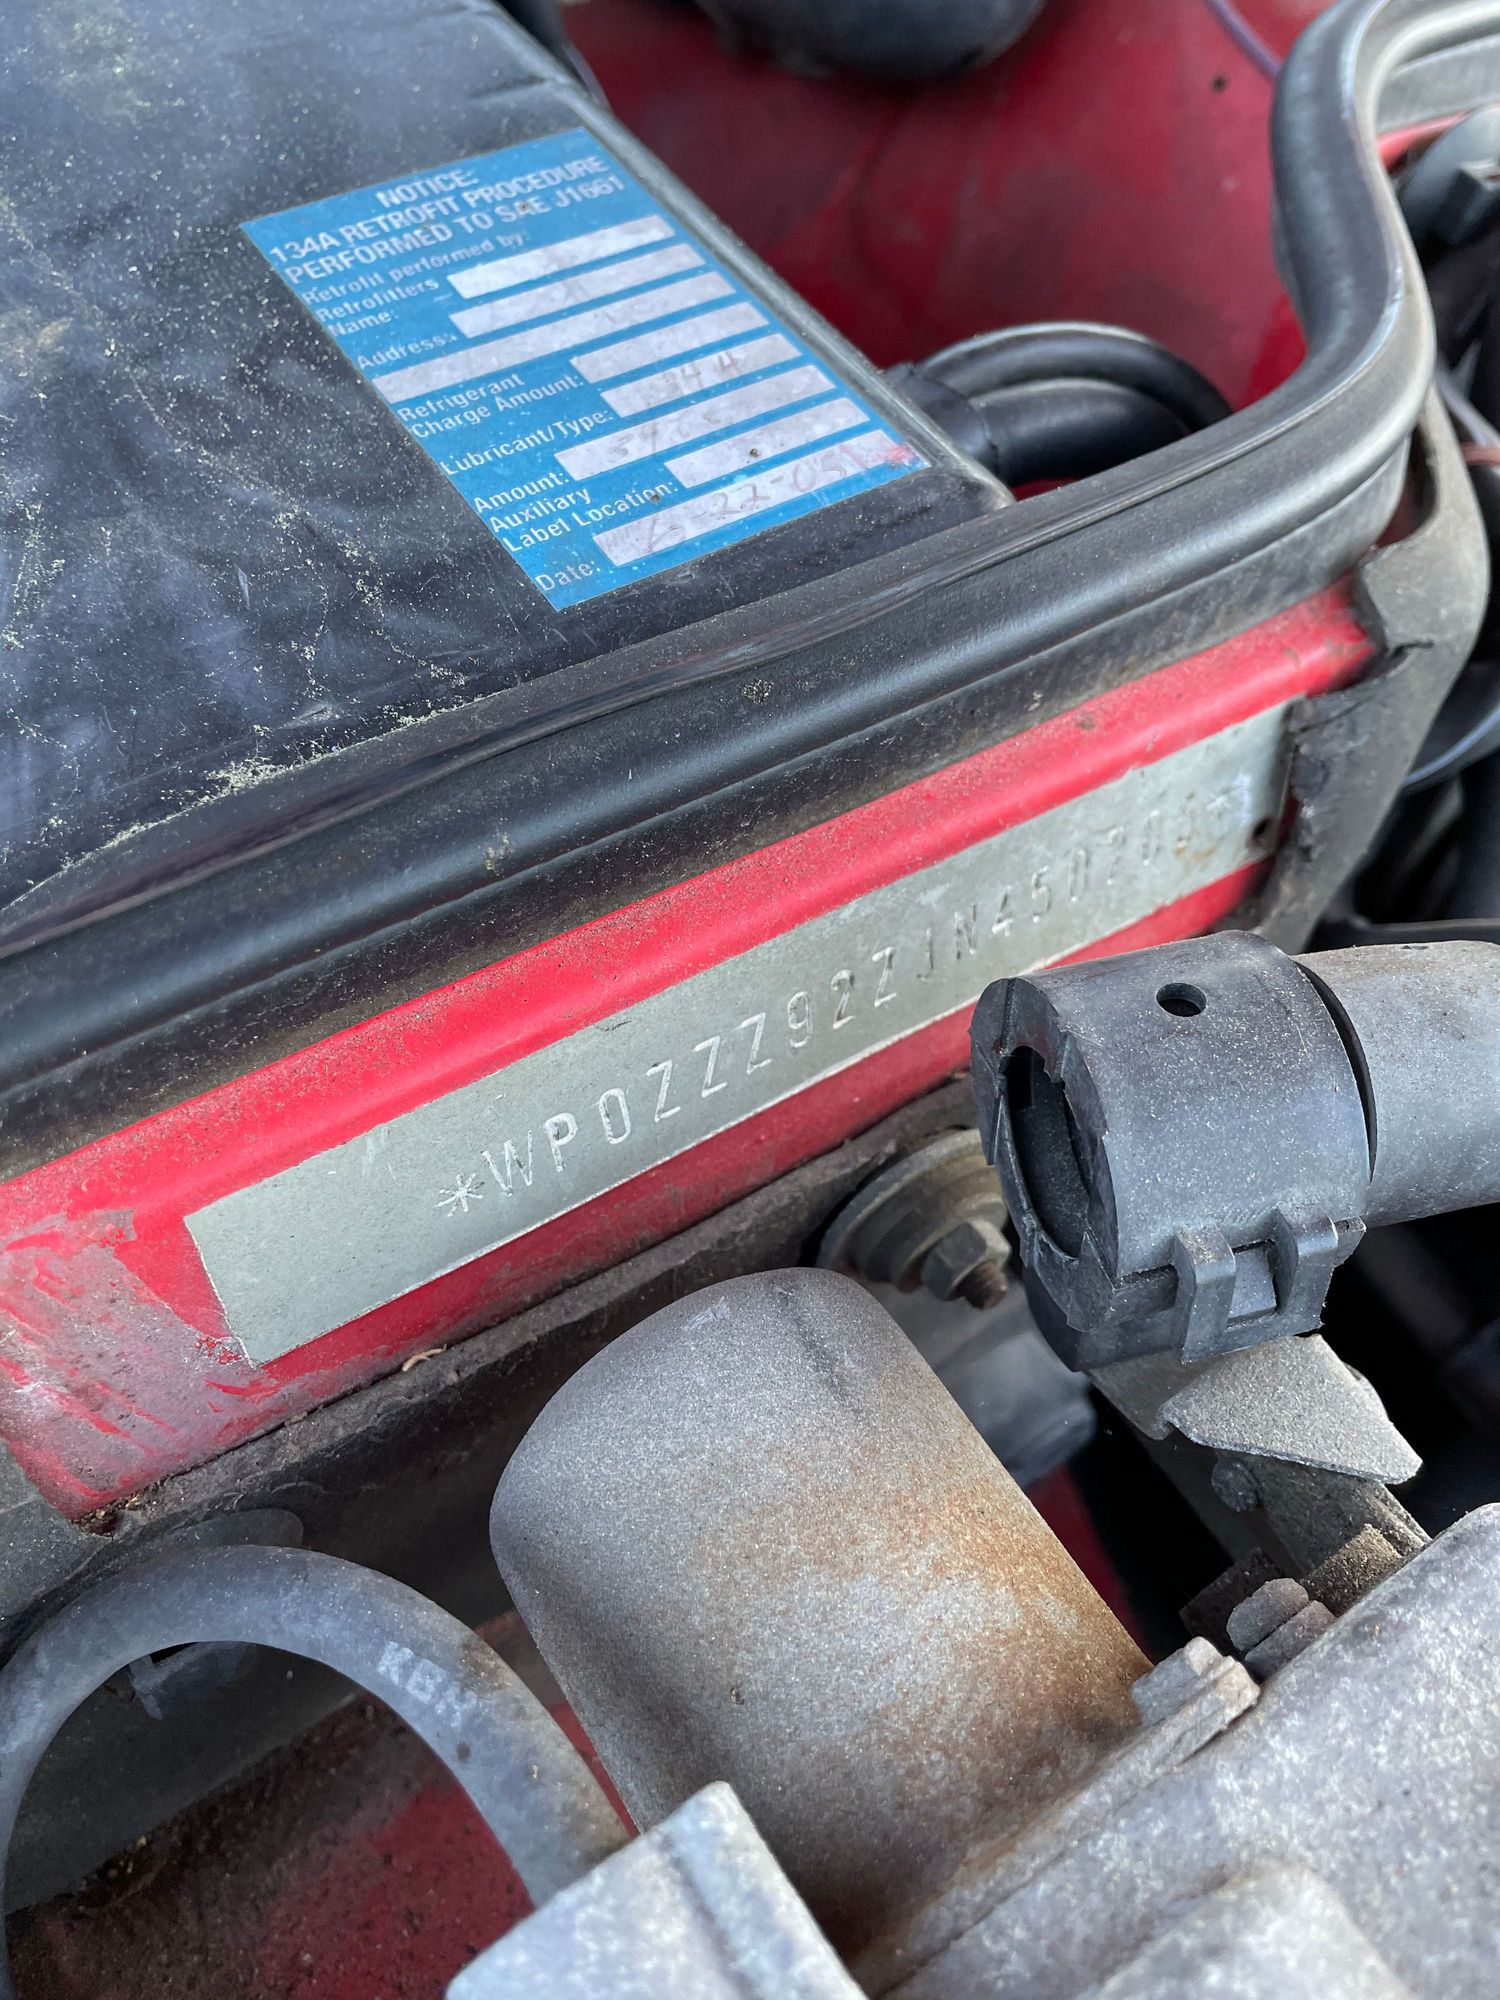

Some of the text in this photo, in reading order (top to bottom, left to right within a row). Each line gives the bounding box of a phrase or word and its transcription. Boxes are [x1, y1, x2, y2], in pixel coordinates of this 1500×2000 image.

[270, 156, 610, 263] 134A RETROFIT PROCEDURE
[375, 169, 480, 208] NOTICE:
[284, 174, 625, 284] PERFORMED TO SAE J1661
[301, 271, 385, 305] Retrofit
[388, 239, 495, 283] performed
[315, 278, 439, 323] Retrofitters
[326, 309, 399, 337] Name:
[397, 373, 525, 423] Refrigerant
[410, 374, 584, 438] Charge Amount:
[439, 409, 614, 475] Lubricant/Type:
[473, 471, 570, 513] Amount:
[489, 488, 592, 533] Auxiliary
[503, 481, 679, 552] Label Location:
[534, 560, 601, 591] Date:
